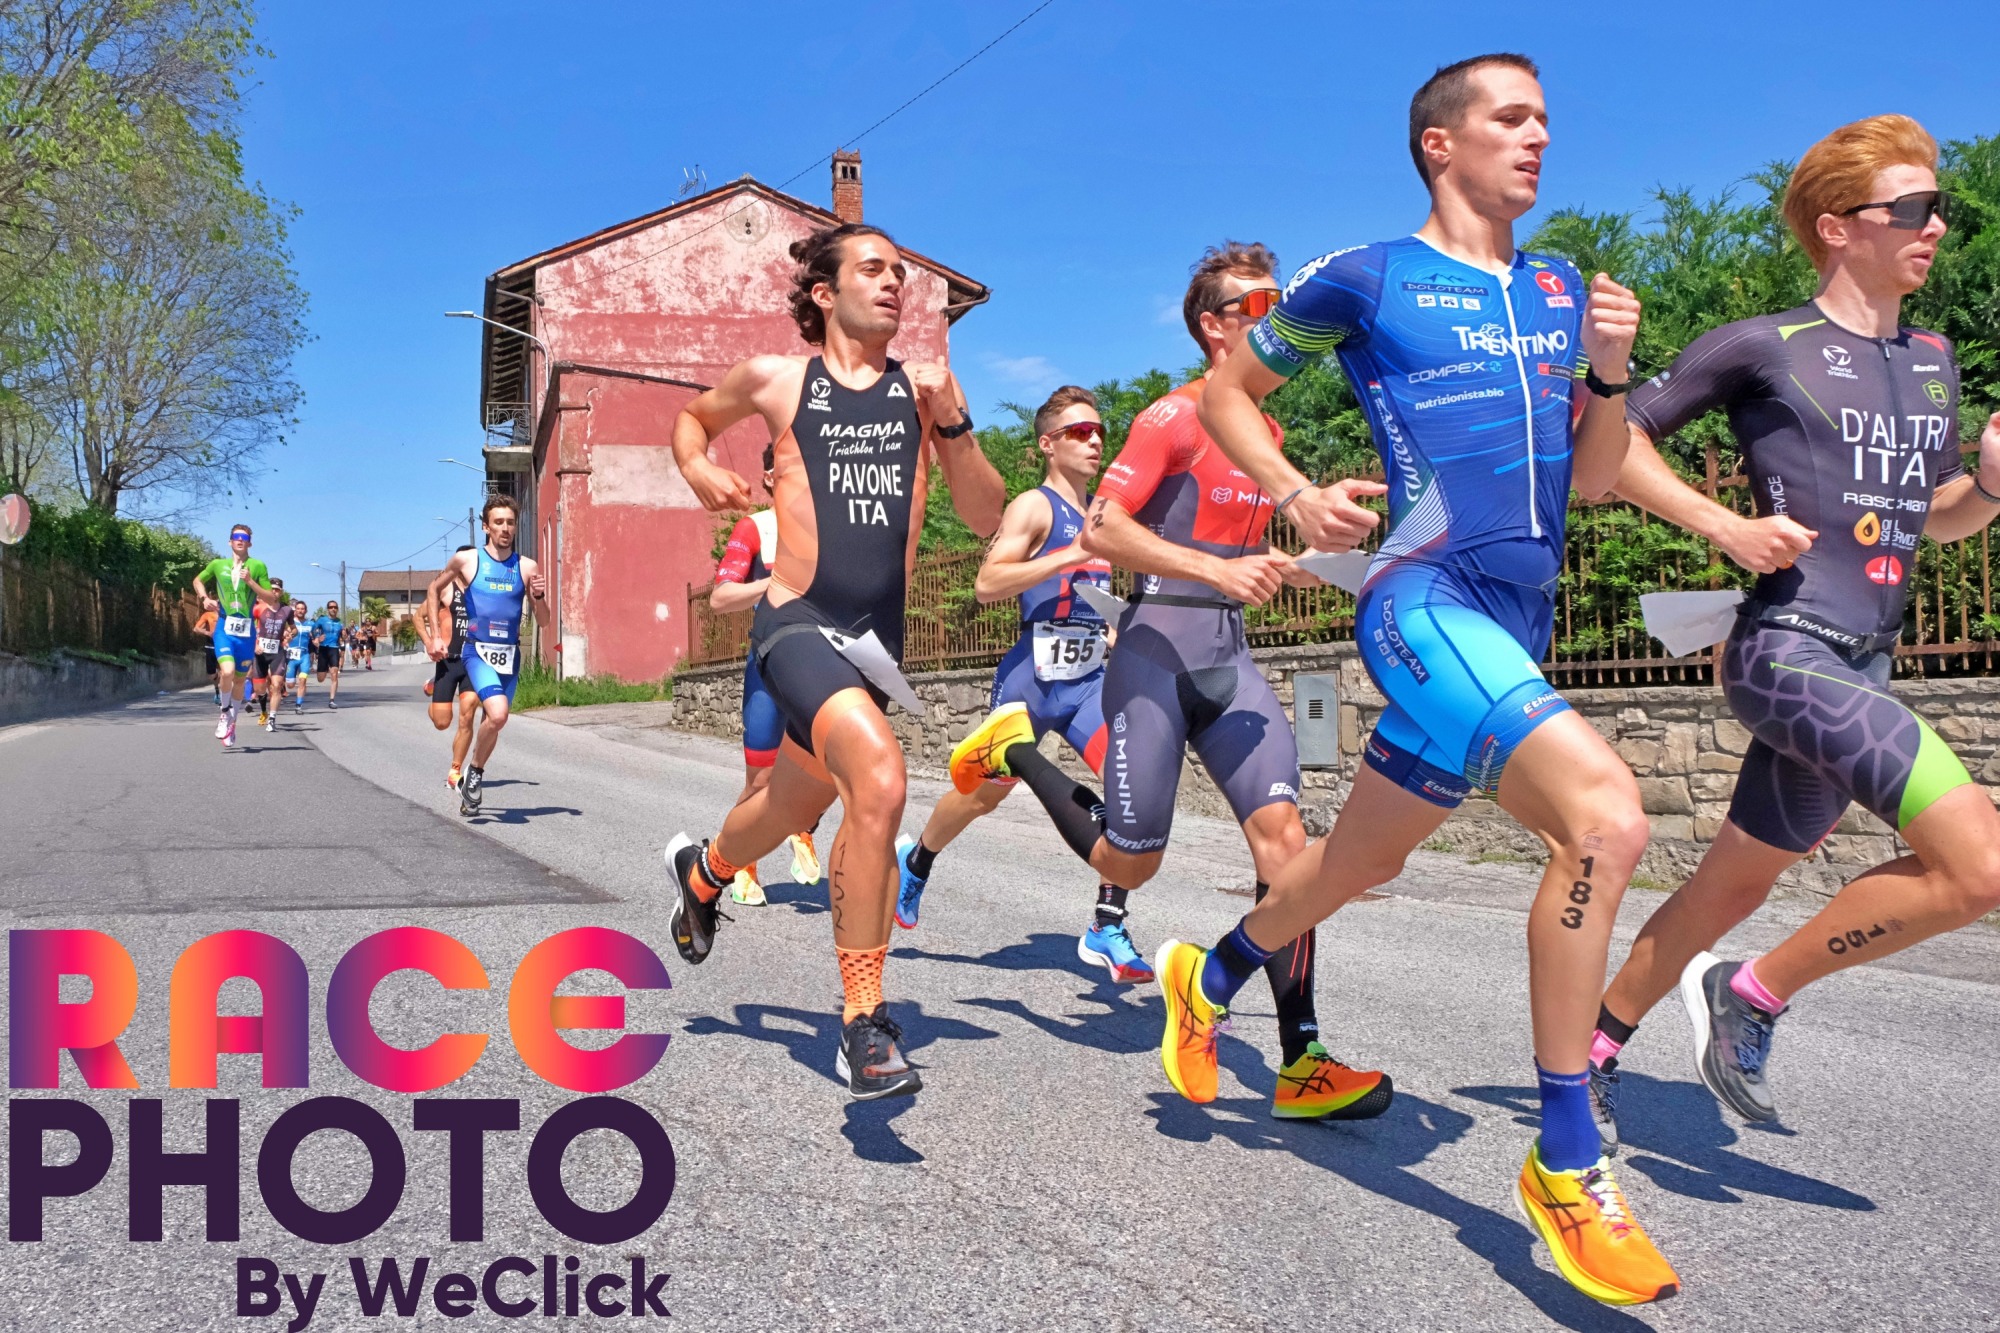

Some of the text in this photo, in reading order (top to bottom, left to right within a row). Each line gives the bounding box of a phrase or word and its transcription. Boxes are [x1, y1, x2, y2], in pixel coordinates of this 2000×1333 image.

[1407, 283, 1485, 295] DOLOTEAM
[1261, 320, 1299, 363] LOTEAM
[1452, 325, 1568, 357] TRENTINO
[1408, 361, 1485, 384] COMPEX
[1826, 369, 1859, 380] Triathlon
[1829, 365, 1852, 374] World
[807, 403, 832, 412] Triathlon
[811, 397, 828, 405] World
[1415, 388, 1504, 411] nutrizionista.bio
[819, 421, 906, 438] MAGMA
[1841, 408, 1949, 451] D'ALTRI
[828, 436, 902, 457] Triathlon Team
[829, 462, 904, 497] PAVONE
[1854, 445, 1927, 488] ITA
[1767, 475, 1788, 516] RVICE
[848, 499, 889, 526] ITA
[1881, 519, 1900, 531] OIL
[230, 622, 246, 634] 151
[1382, 598, 1426, 681] DOLOTEAM
[1051, 638, 1096, 665] 155
[1115, 738, 1137, 824] MININI
[1106, 828, 1168, 850] Santini
[834, 841, 846, 932] 152
[1560, 855, 1595, 930] 183
[1827, 923, 1887, 955] 150
